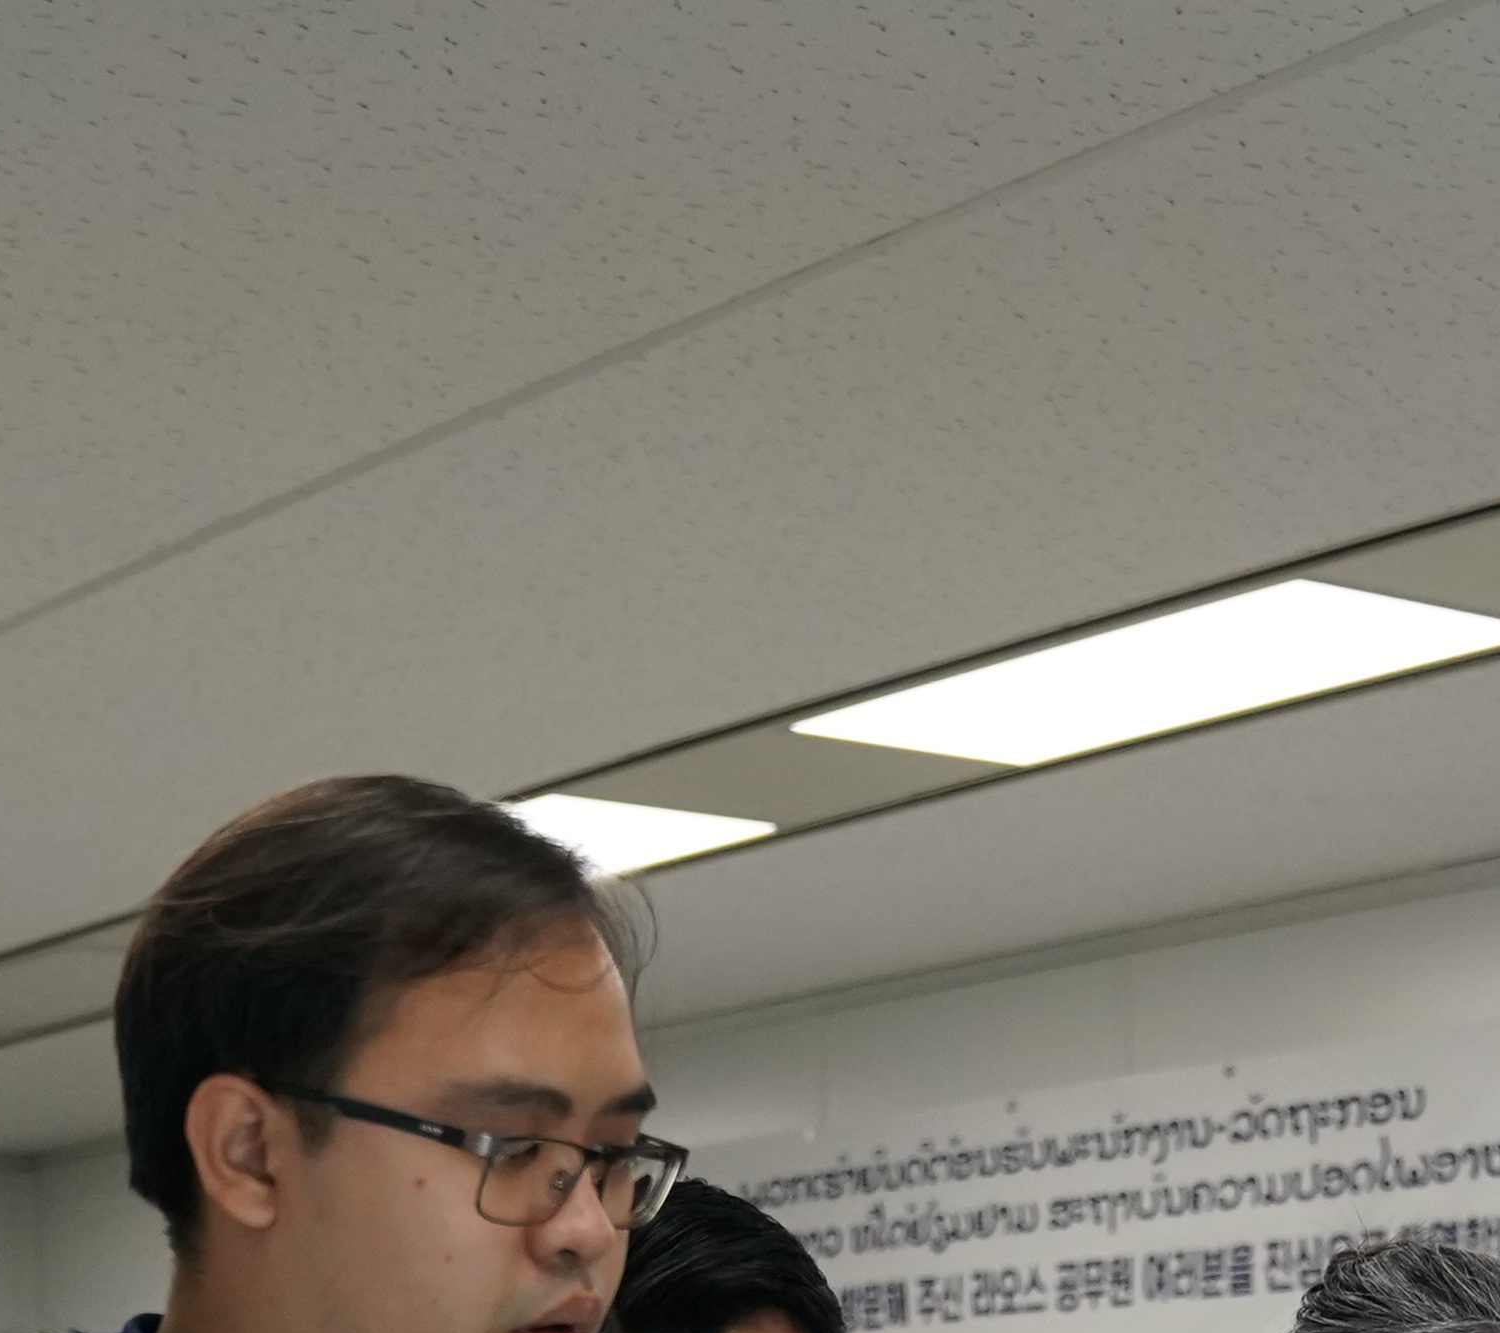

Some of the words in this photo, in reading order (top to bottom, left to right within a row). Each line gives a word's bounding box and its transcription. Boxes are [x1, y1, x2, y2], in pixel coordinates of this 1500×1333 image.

[919, 1277, 964, 1325] 주신
[972, 1265, 1047, 1316] 라오스
[1056, 1257, 1134, 1312] 공무원
[1144, 1243, 1253, 1300] 여러분을
